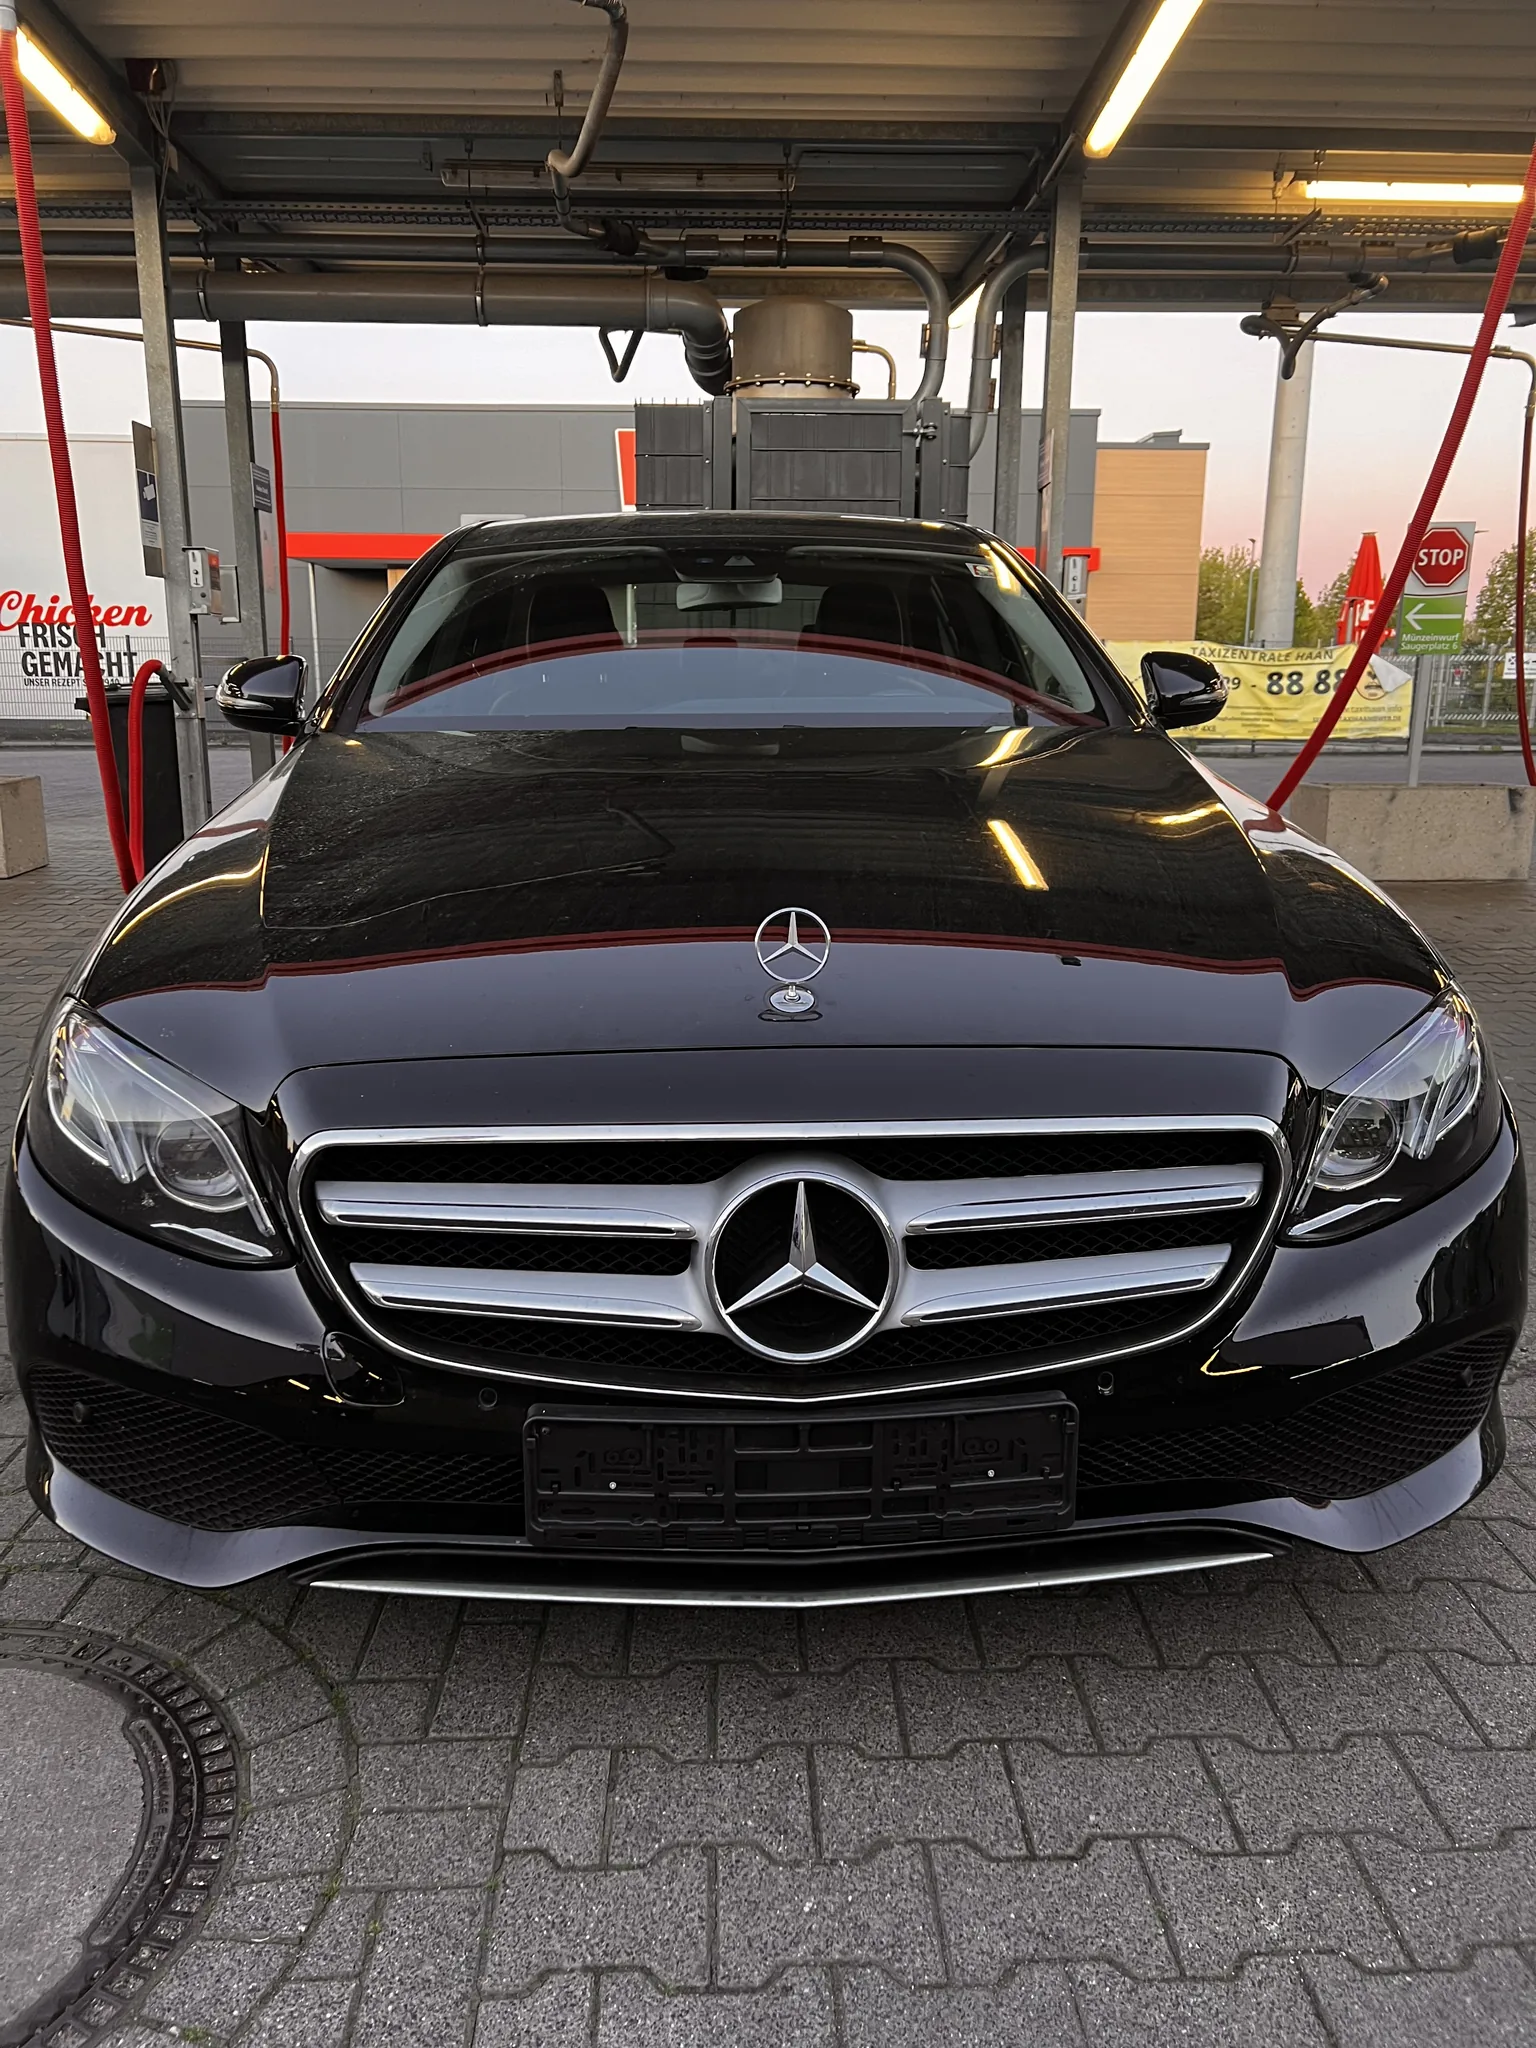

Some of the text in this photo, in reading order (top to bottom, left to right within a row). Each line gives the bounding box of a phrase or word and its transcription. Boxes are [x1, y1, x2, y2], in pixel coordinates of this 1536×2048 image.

[1418, 548, 1464, 566] STOP
[1402, 633, 1460, 642] Münzeinwurf
[1401, 642, 1459, 652] Saugerplatz 6
[1190, 646, 1333, 662] TAXIZENTRALE HAAN
[23, 678, 50, 687] UNSER
[51, 678, 80, 687] REZEPT
[1266, 671, 1304, 695] 88
